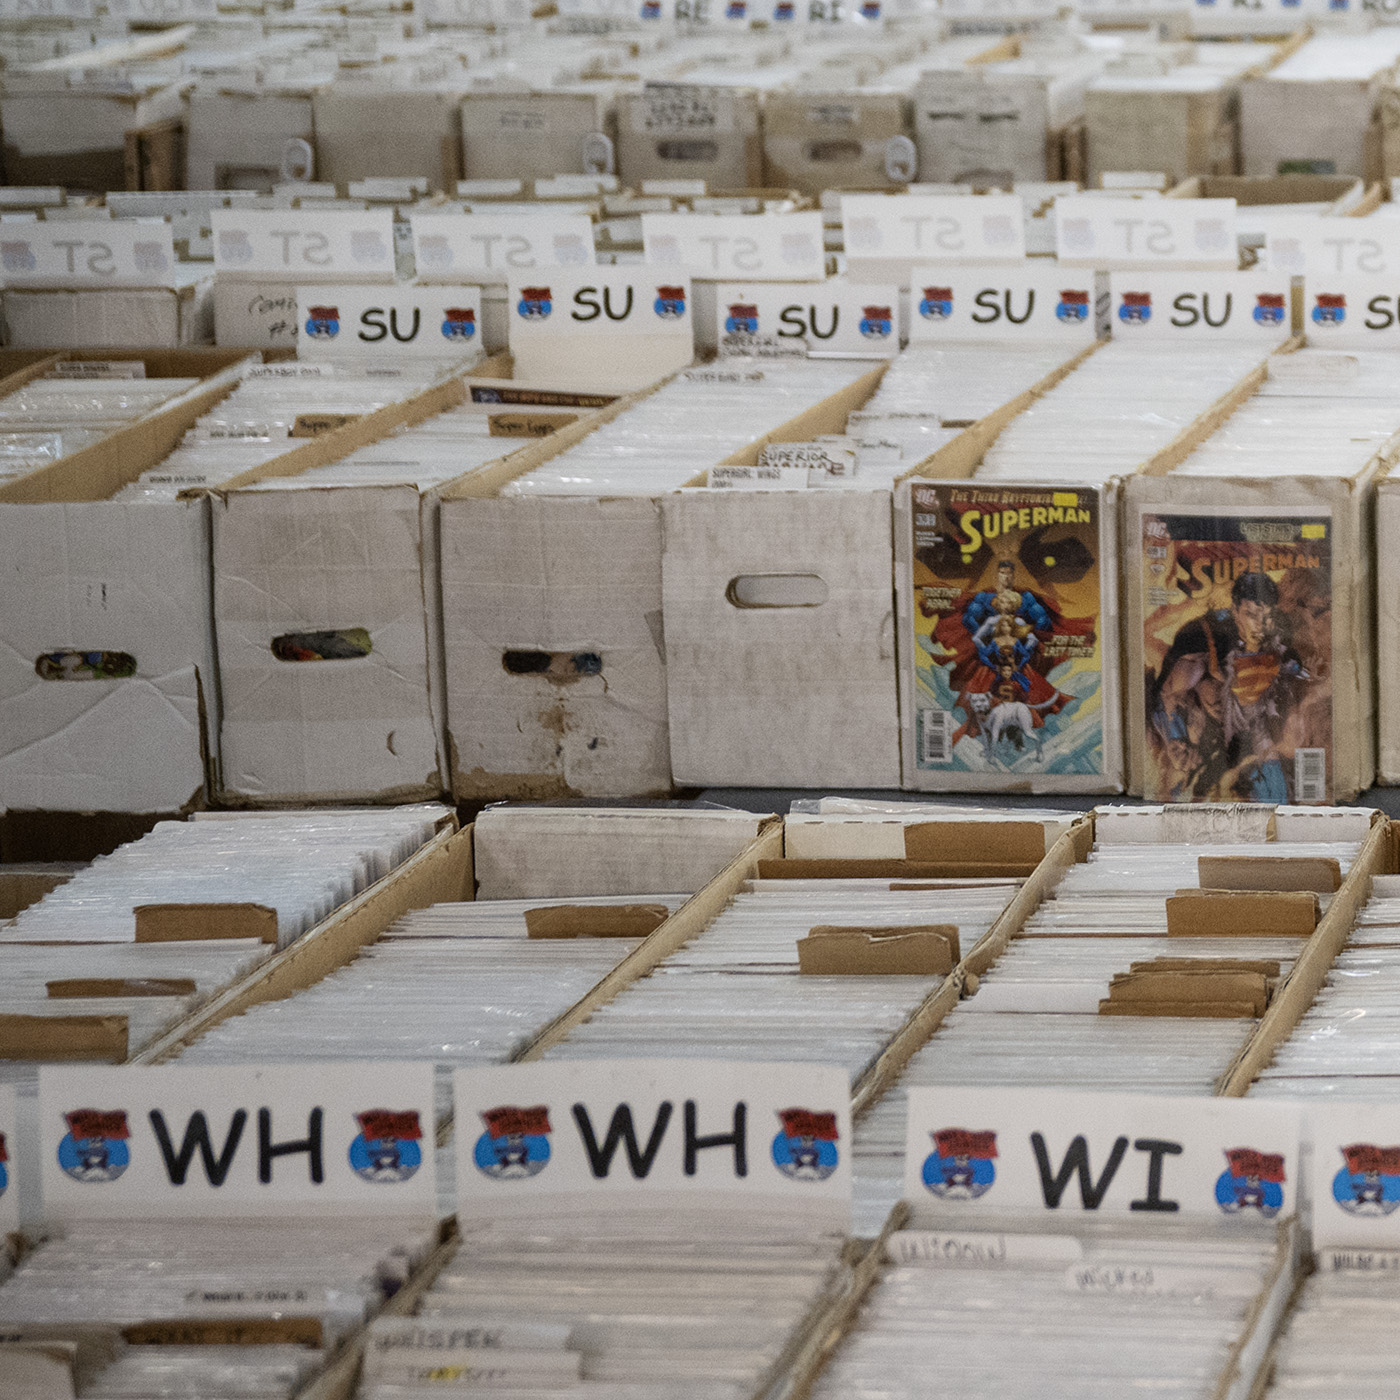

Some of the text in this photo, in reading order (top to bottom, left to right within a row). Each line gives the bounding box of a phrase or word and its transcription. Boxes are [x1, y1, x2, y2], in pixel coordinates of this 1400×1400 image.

[571, 285, 634, 322] SU
[777, 305, 839, 339] SU
[971, 288, 1035, 325] SU
[1170, 292, 1233, 328] SU
[358, 306, 421, 343] SU
[960, 506, 1091, 554] SUPERMAN
[1191, 554, 1320, 600] SUPERMAN
[148, 1107, 325, 1188] WH
[571, 1099, 749, 1180] WH
[1030, 1131, 1184, 1213] WI
